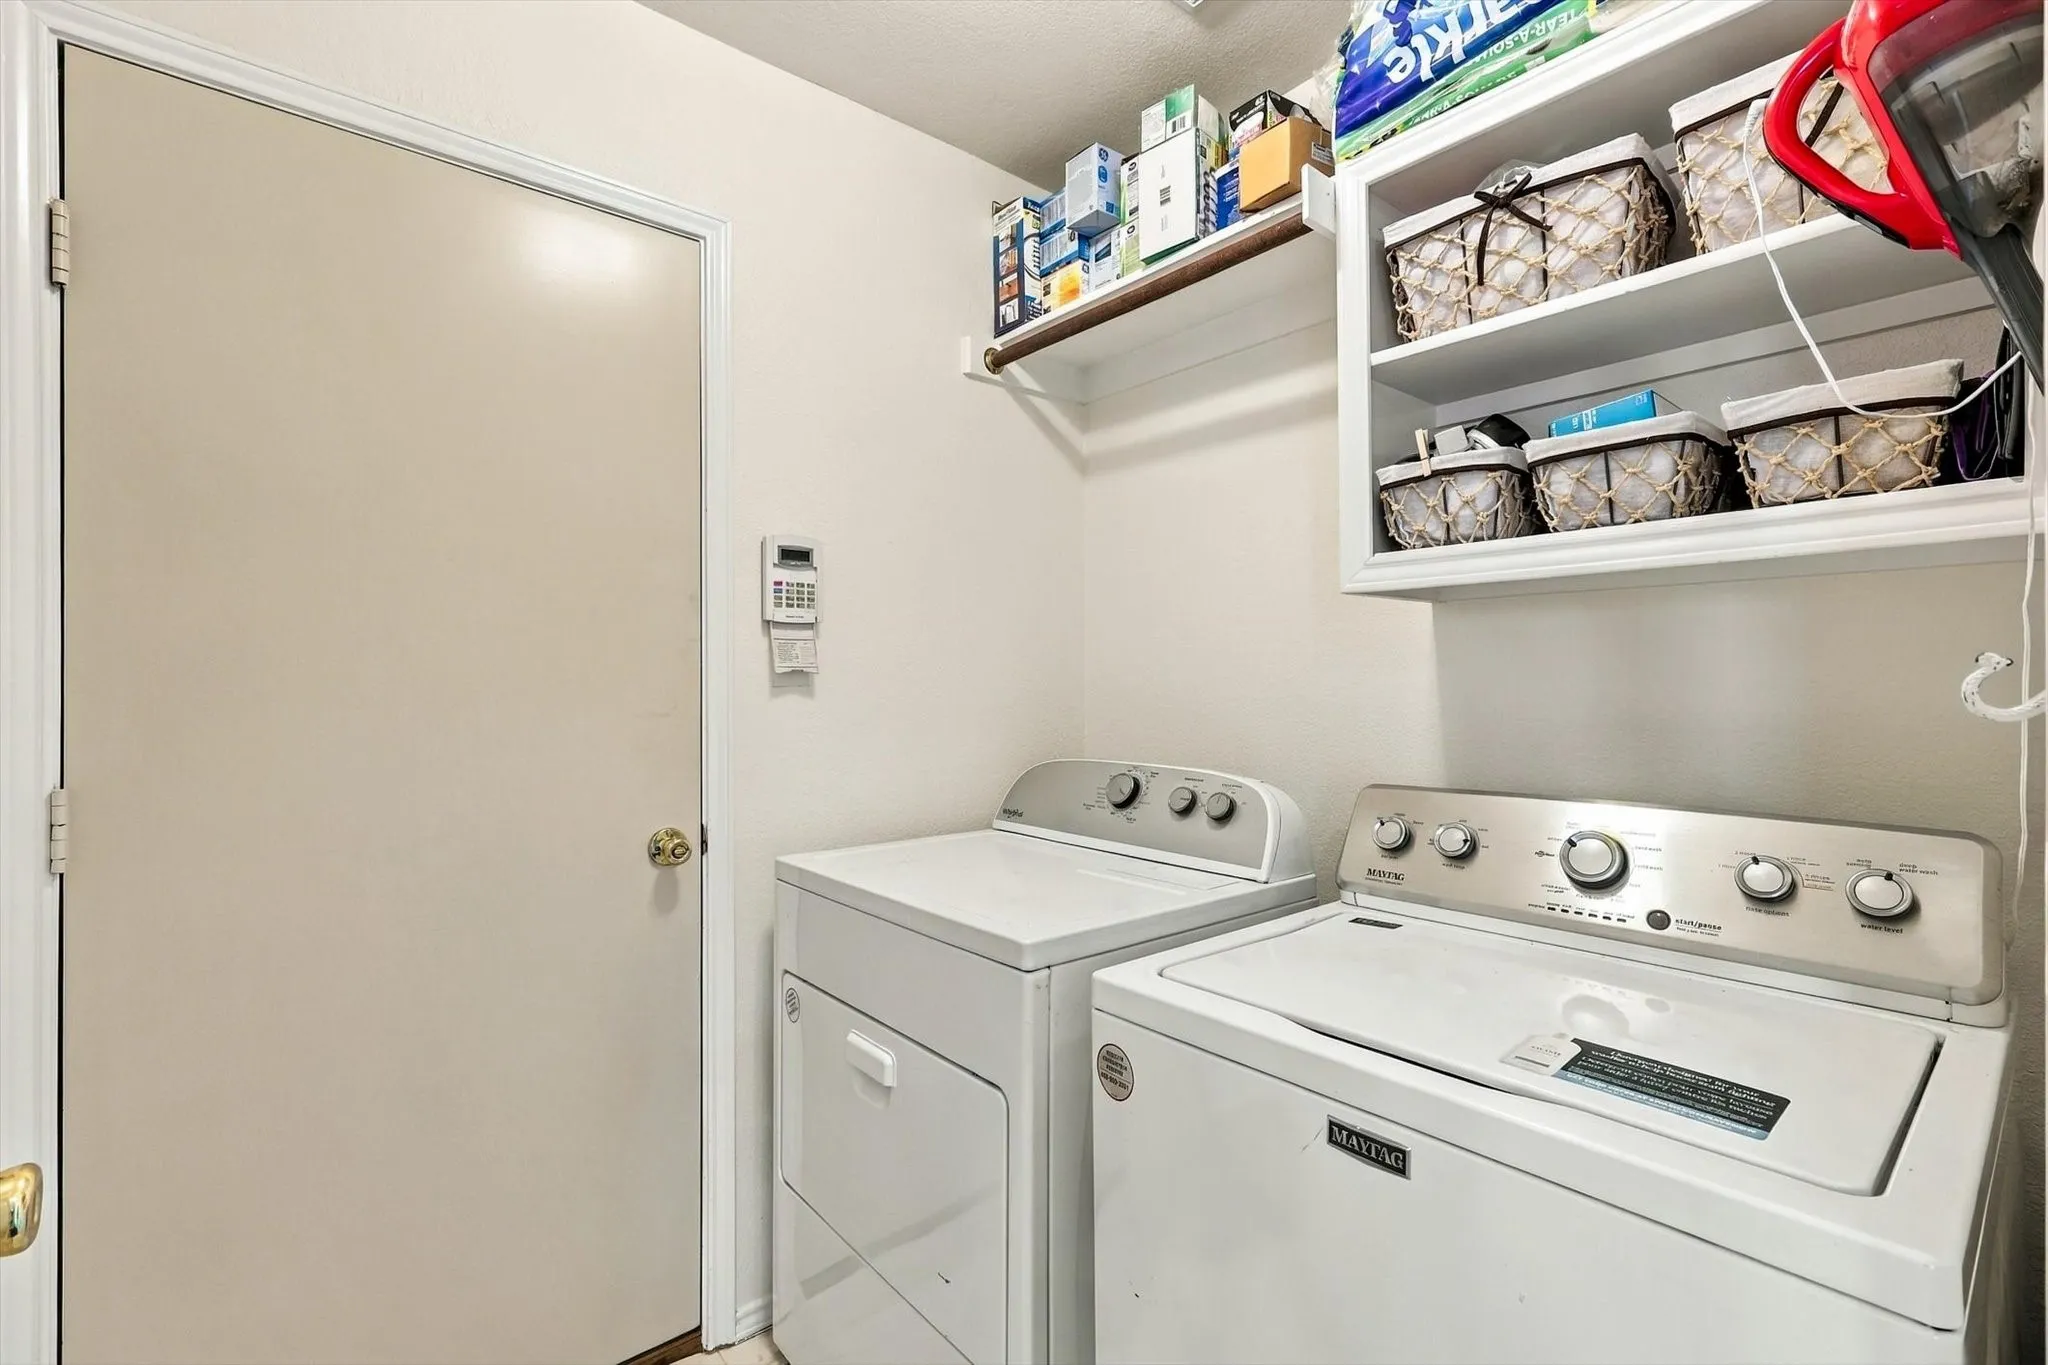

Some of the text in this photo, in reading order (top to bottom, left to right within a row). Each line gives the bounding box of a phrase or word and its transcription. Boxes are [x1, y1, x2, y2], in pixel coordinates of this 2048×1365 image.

[1383, 0, 1541, 84] arkle
[1366, 868, 1405, 881] MAYTAG
[1763, 908, 1790, 917] options
[1675, 919, 1722, 930] start/pause
[1861, 923, 1904, 934] water level
[1331, 1125, 1404, 1169] MAYTAG
